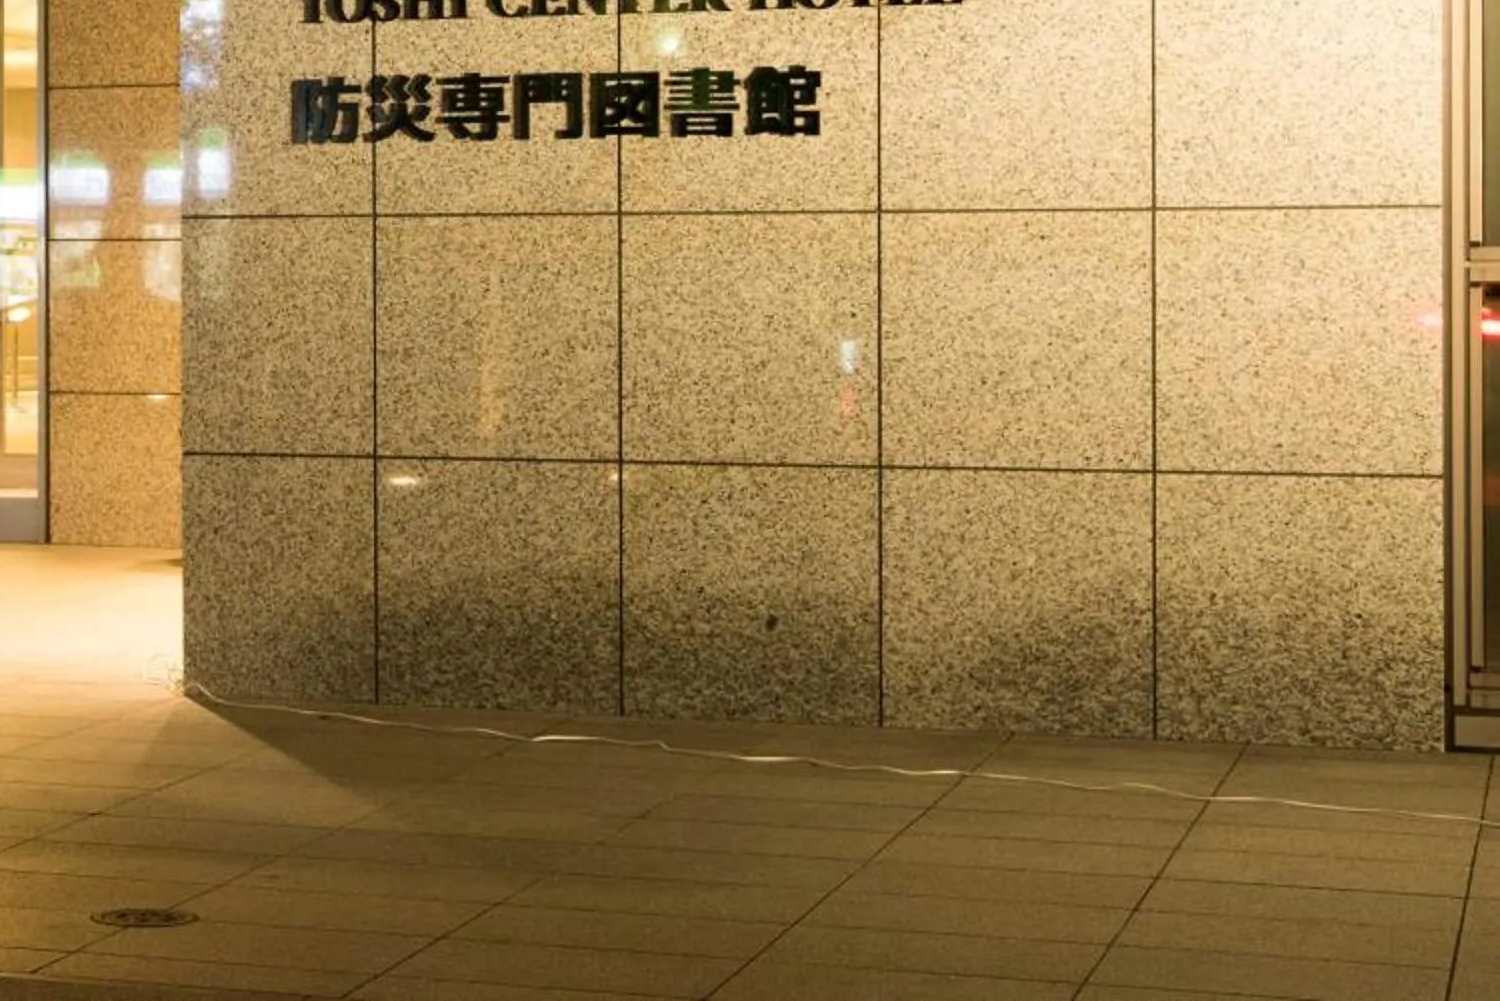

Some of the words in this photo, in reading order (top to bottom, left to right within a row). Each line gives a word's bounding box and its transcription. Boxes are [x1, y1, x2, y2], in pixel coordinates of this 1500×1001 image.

[291, 65, 822, 144] 防災専門図書館
